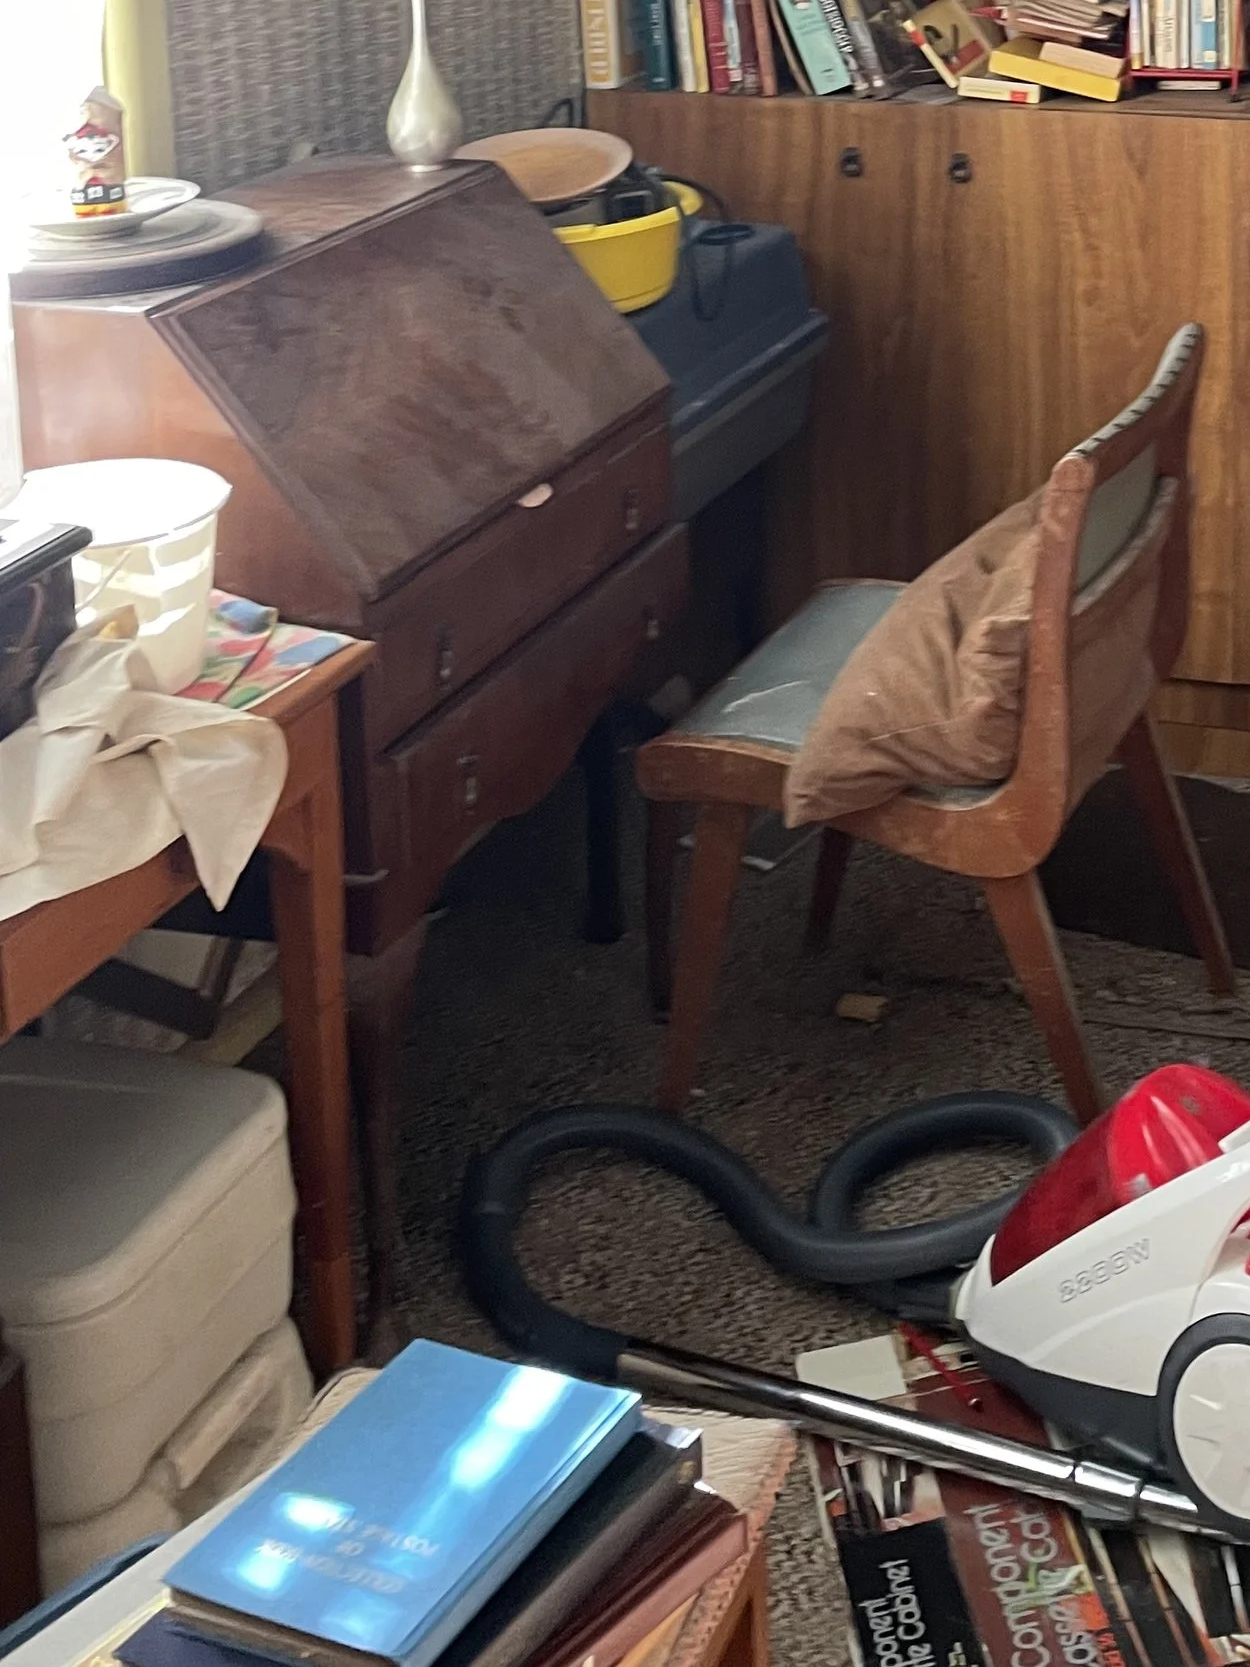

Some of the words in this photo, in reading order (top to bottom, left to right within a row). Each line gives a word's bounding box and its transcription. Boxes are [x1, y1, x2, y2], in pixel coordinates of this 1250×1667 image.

[1058, 1237, 1150, 1303] 2200W
[878, 1558, 927, 1640] Cabinet
[963, 1502, 1050, 1667] Component
